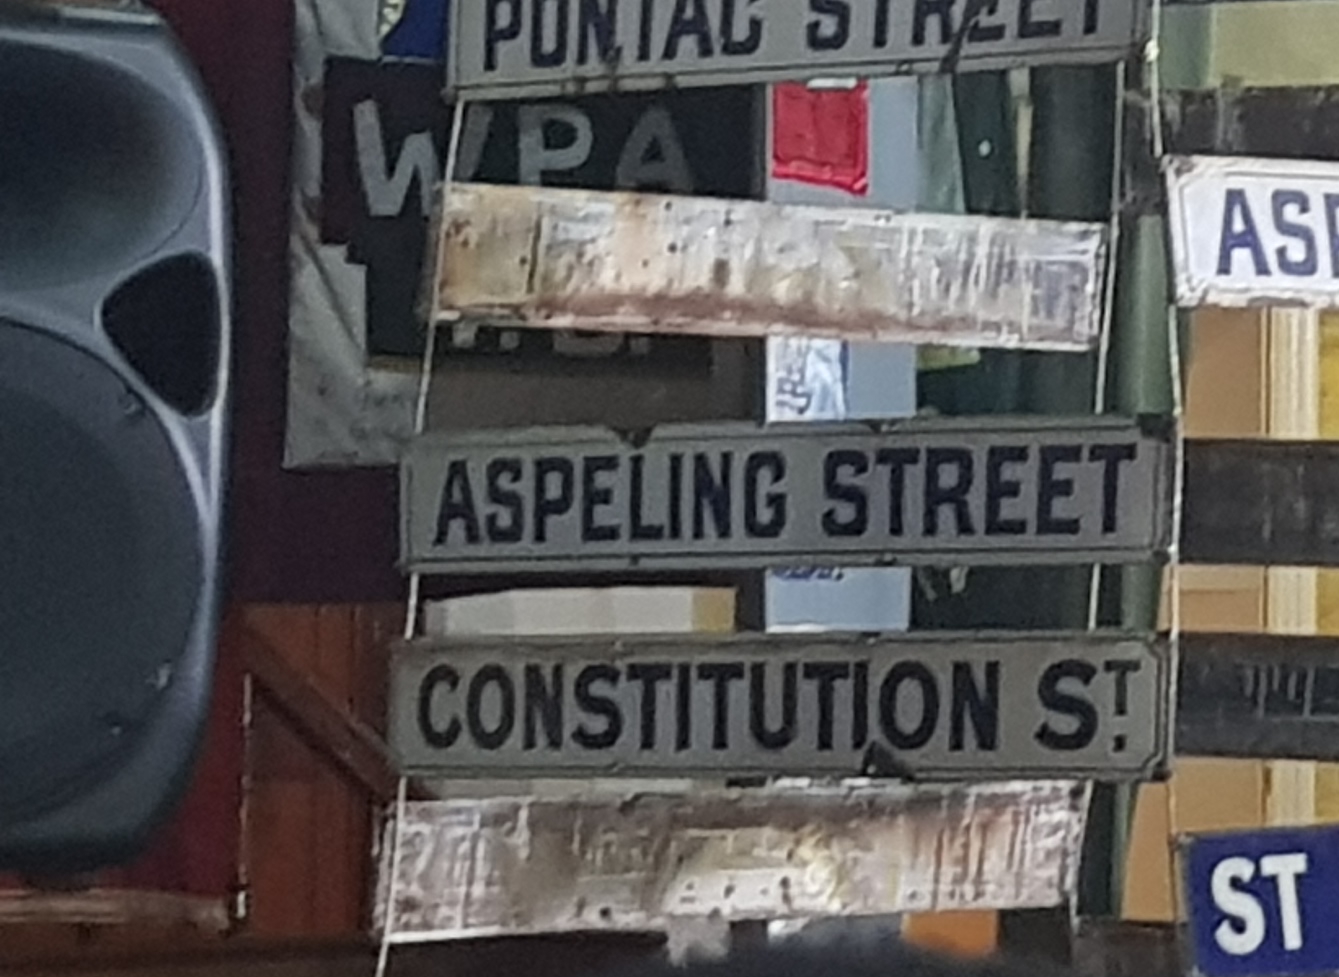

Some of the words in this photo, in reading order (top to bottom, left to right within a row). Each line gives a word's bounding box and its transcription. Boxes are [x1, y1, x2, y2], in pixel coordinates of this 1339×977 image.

[433, 450, 787, 546] ASPELING
[821, 442, 1138, 539] STREET
[418, 659, 998, 752] CONSTITUTION
[1211, 853, 1308, 955] ST
